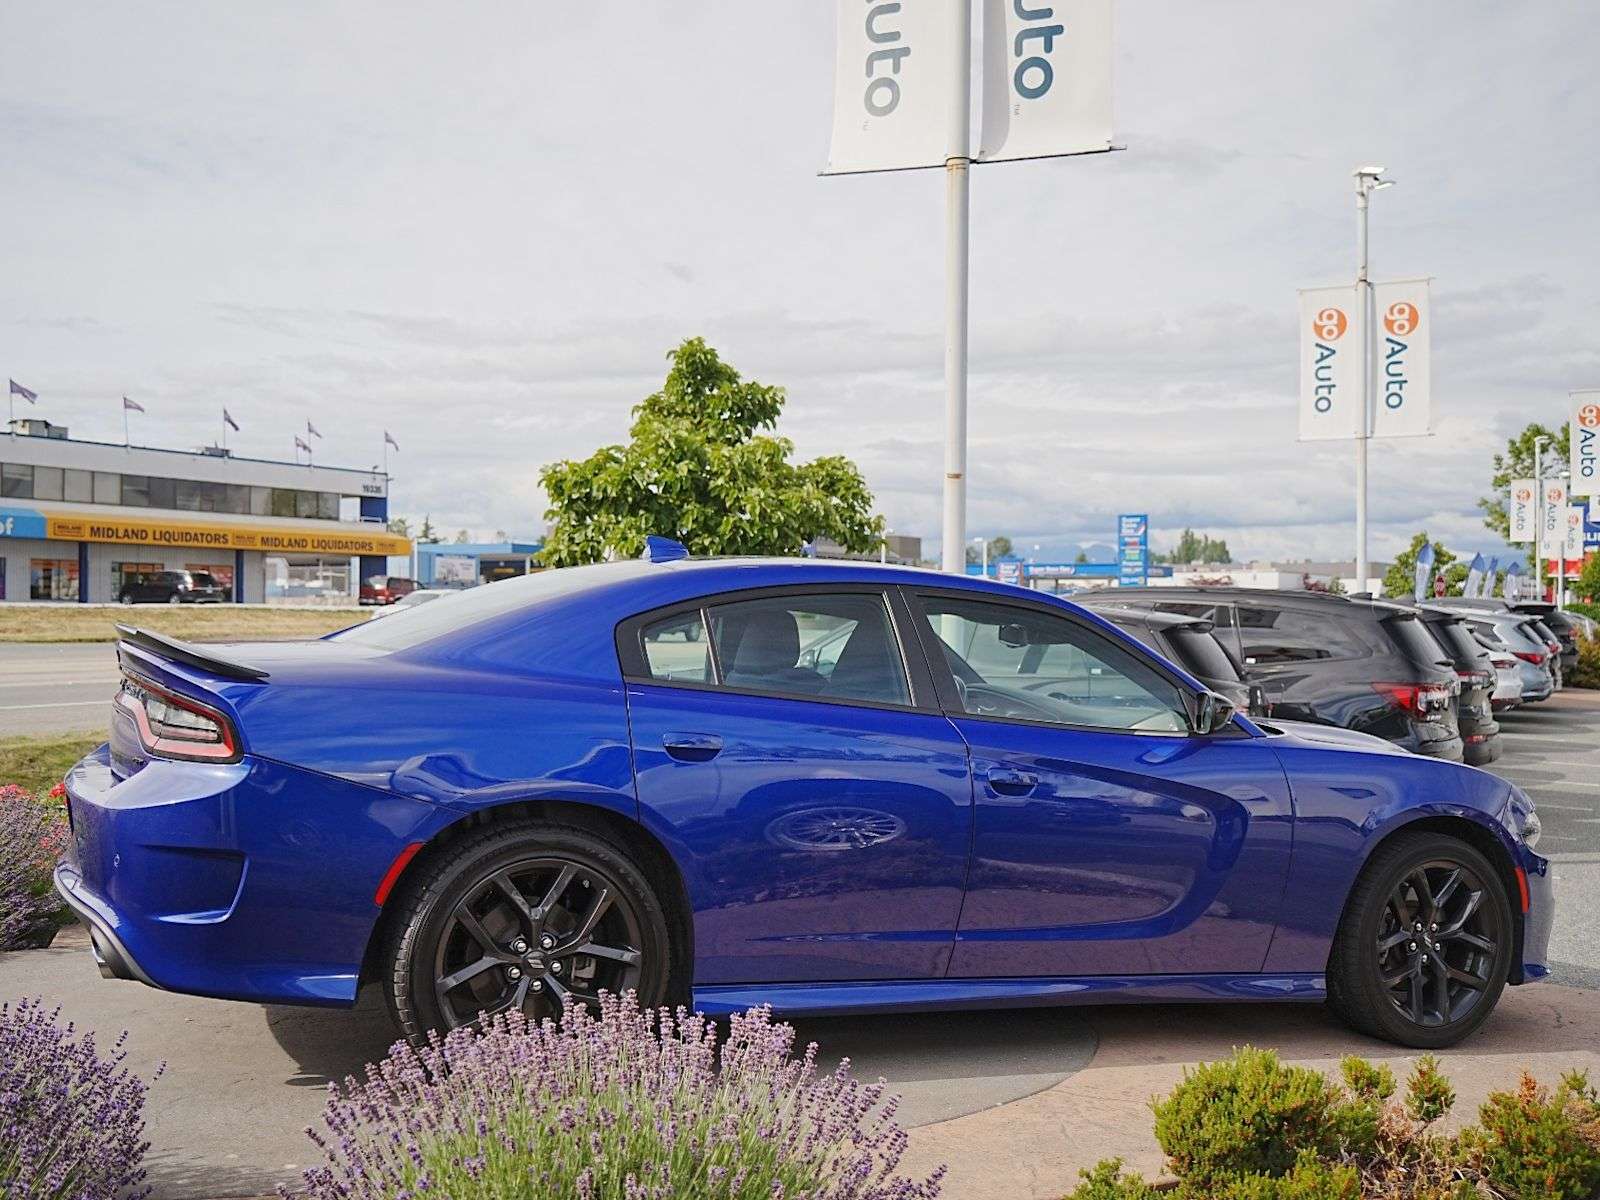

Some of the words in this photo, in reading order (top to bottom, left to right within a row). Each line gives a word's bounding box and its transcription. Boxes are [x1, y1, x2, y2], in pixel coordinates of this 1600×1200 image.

[864, 0, 911, 117] uto
[1314, 343, 1337, 412] Auto
[1385, 337, 1408, 409] Auto
[1580, 428, 1597, 478] Auto
[90, 526, 148, 541] MIDLAND
[153, 530, 230, 545] LIQUIDATORS
[1516, 502, 1526, 531] Auto
[1547, 502, 1557, 531] Auto
[260, 536, 308, 549] MIDLAND
[311, 539, 373, 552] LIQUIDATORS
